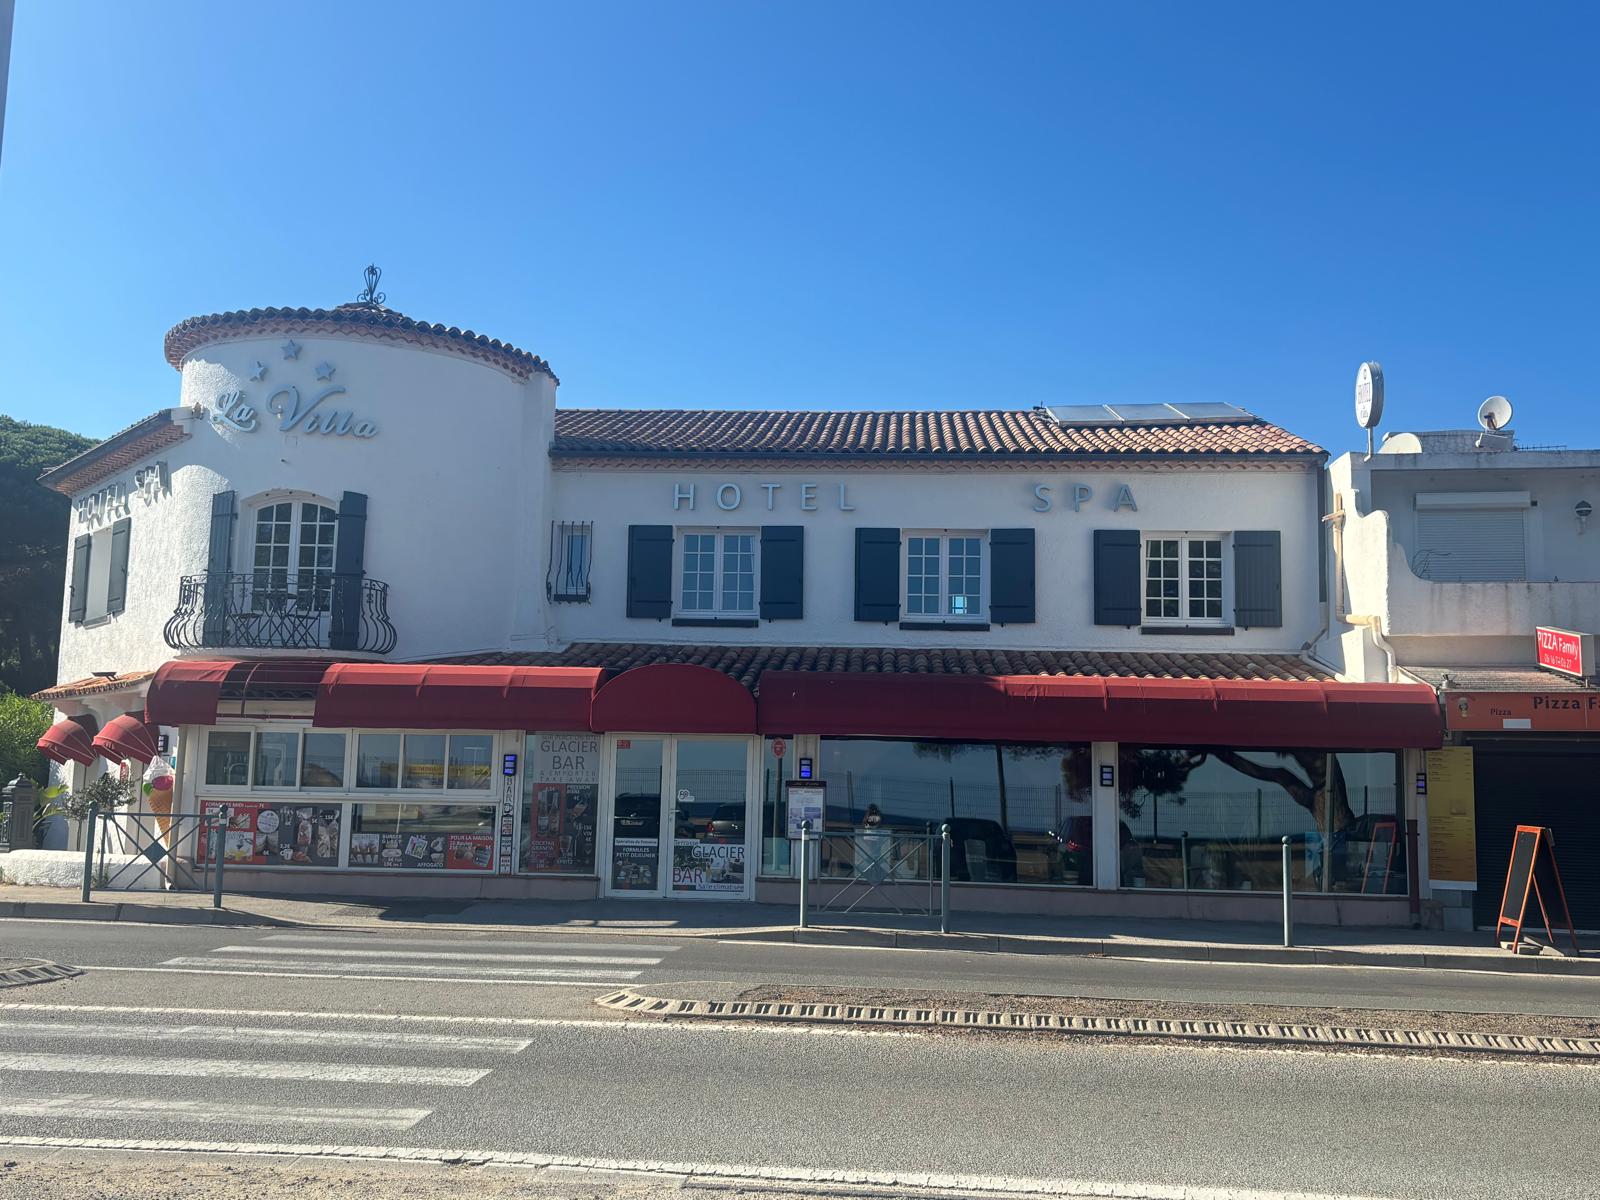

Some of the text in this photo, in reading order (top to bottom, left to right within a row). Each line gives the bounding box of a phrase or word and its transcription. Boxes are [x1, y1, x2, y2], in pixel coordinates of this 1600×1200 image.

[210, 385, 380, 438] La Villa
[78, 483, 127, 523] HOTEL
[673, 483, 856, 511] HOTEL
[1033, 483, 1138, 512] SPA
[1537, 631, 1579, 660] PIZZA Family
[1533, 696, 1600, 710] Pizza F
[1490, 708, 1512, 716] Pizza
[541, 740, 598, 753] GLACIER
[552, 755, 585, 770] BAR
[692, 845, 745, 859] GLACIER
[672, 867, 703, 883] BAR
